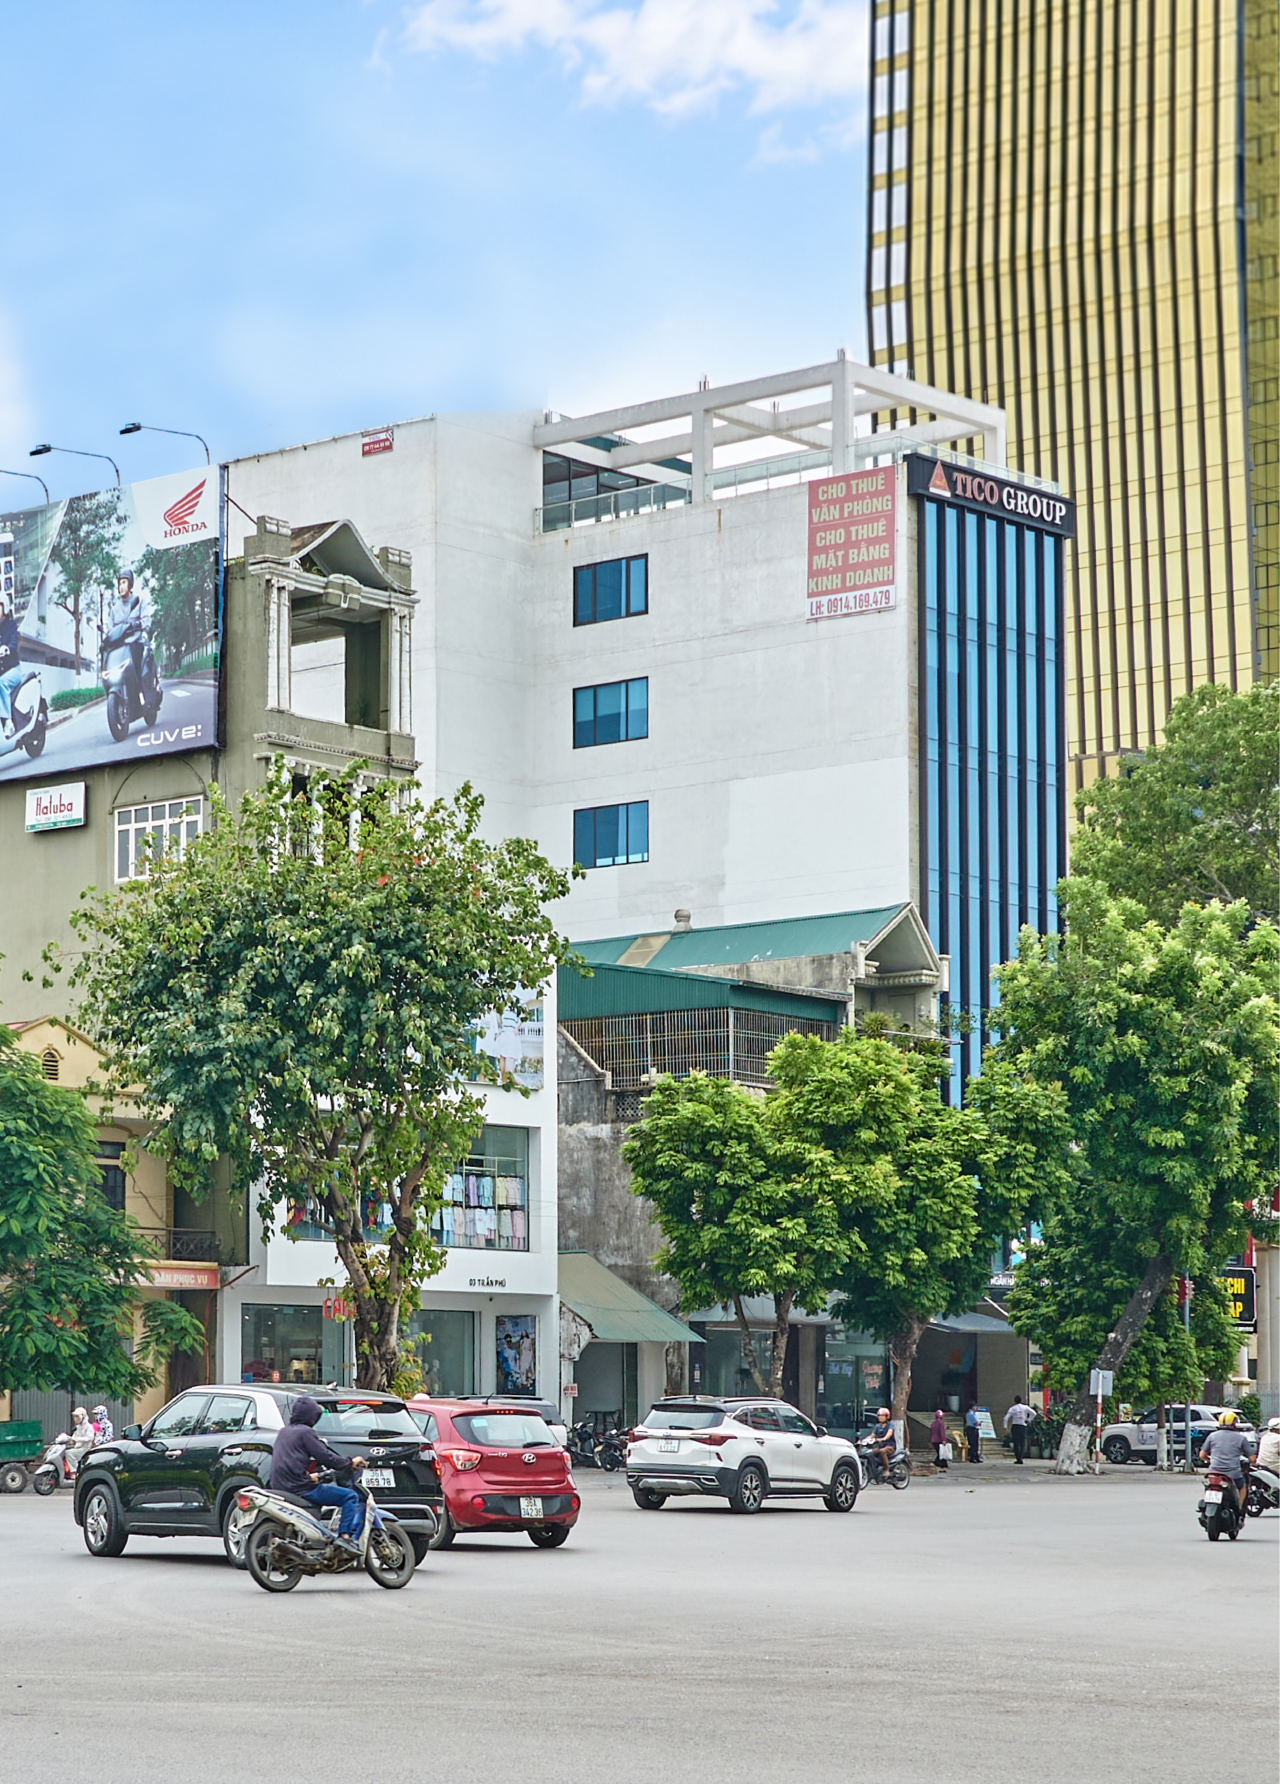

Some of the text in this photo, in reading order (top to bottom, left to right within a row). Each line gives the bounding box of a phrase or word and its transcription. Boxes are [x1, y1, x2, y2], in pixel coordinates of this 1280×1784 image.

[818, 472, 885, 501] CHO THUÊ
[952, 472, 1066, 525] TICO GROUP
[811, 495, 892, 523] VĂN PHÒNG
[164, 522, 207, 538] HONDA
[816, 518, 887, 547] CHO THUÊ
[813, 542, 890, 571] MẶT BẰNG
[809, 565, 893, 593] KINH DOANH
[810, 589, 890, 616] LH: 0914.169.479
[35, 793, 73, 816] Hatuba
[174, 1274, 195, 1285] PHỤC
[197, 1274, 208, 1286] VỤ
